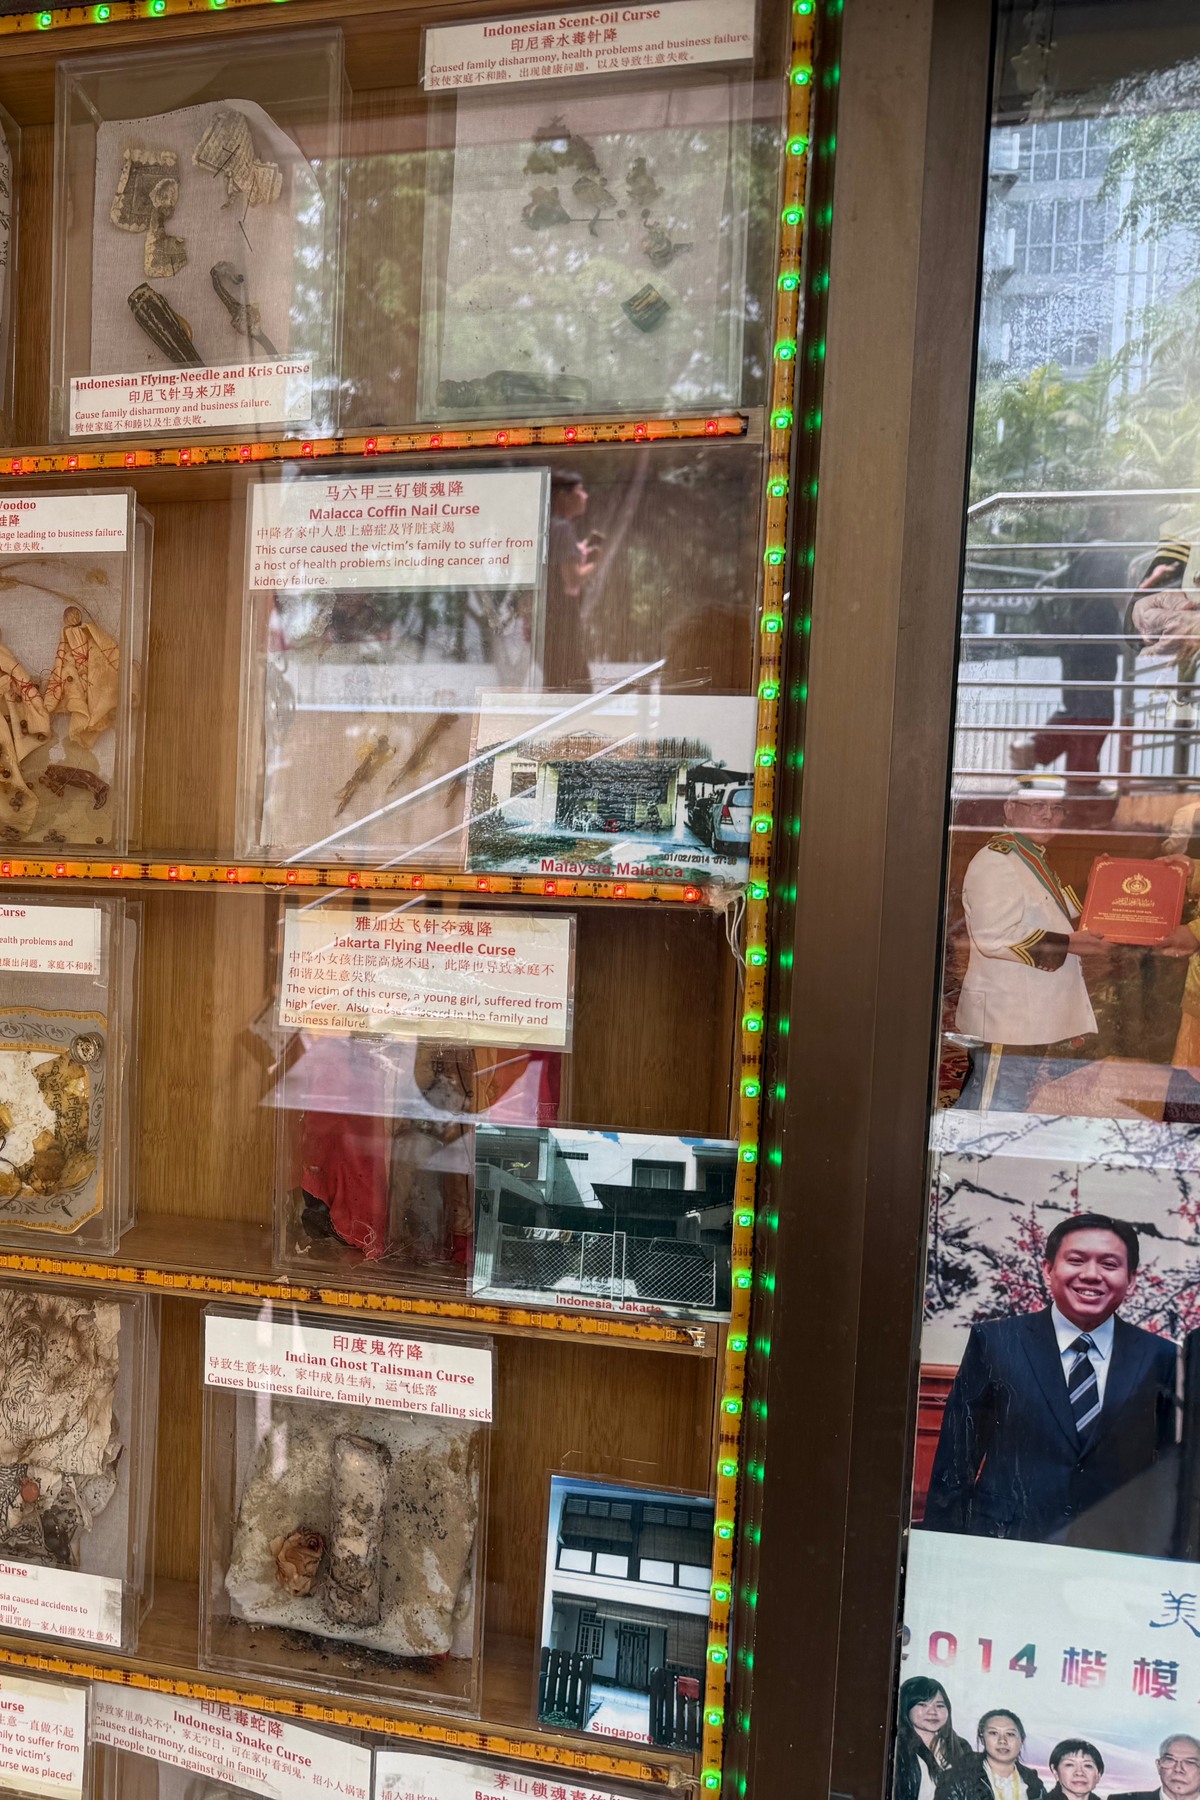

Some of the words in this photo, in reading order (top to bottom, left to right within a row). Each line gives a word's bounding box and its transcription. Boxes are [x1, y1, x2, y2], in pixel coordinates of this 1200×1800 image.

[483, 22, 555, 37] Indonesian
[559, 13, 619, 30] Scent-Oil
[623, 11, 660, 23] Curse
[510, 28, 618, 52] 印尼香水毒针降
[76, 377, 138, 391] Indonesian
[140, 370, 219, 389] Flying-Needle
[223, 368, 244, 380] and
[248, 367, 272, 378] Kris
[276, 365, 310, 376] Curse
[129, 383, 236, 403] 印尼飞针马来刀降
[326, 480, 464, 501] 马六甲三钉锁魂降
[309, 508, 363, 520] Malacca
[367, 506, 406, 519] Coffin
[412, 504, 437, 517] Nail
[441, 504, 479, 516] Curse
[255, 544, 276, 555] This
[279, 546, 307, 555] curse
[310, 542, 348, 554] caused
[351, 541, 368, 553] the
[371, 540, 414, 552] victim’s
[416, 539, 452, 553] family
[454, 540, 466, 550] to
[469, 538, 502, 550] suffer
[505, 537, 533, 549] from
[355, 916, 493, 937] 雅加达飞针夺魂降
[334, 936, 380, 950] Jakarta
[384, 938, 422, 955] Flying
[426, 940, 473, 954] Needle
[477, 942, 515, 956] Curse
[556, 1294, 615, 1311] Indonesia,
[618, 1301, 662, 1314] Jakarta
[333, 1335, 423, 1361] 印度鬼符降
[285, 1350, 326, 1367] Indian
[330, 1356, 368, 1371] Ghost
[373, 1361, 432, 1379] Talisman
[436, 1369, 475, 1384] Curse
[207, 1373, 244, 1389] Causes
[247, 1378, 293, 1395] business
[296, 1384, 335, 1401] failure,
[337, 1389, 371, 1407] family
[374, 1396, 427, 1411] members
[431, 1400, 466, 1419] falling
[469, 1407, 491, 1419] sick
[15, 1732, 25, 1743] to
[27, 1735, 54, 1748] suffer
[57, 1738, 80, 1753] from
[173, 1710, 232, 1741] Indonesia
[237, 1731, 272, 1754] Snake
[276, 1743, 311, 1767] Curse
[592, 1722, 654, 1742] Singapore
